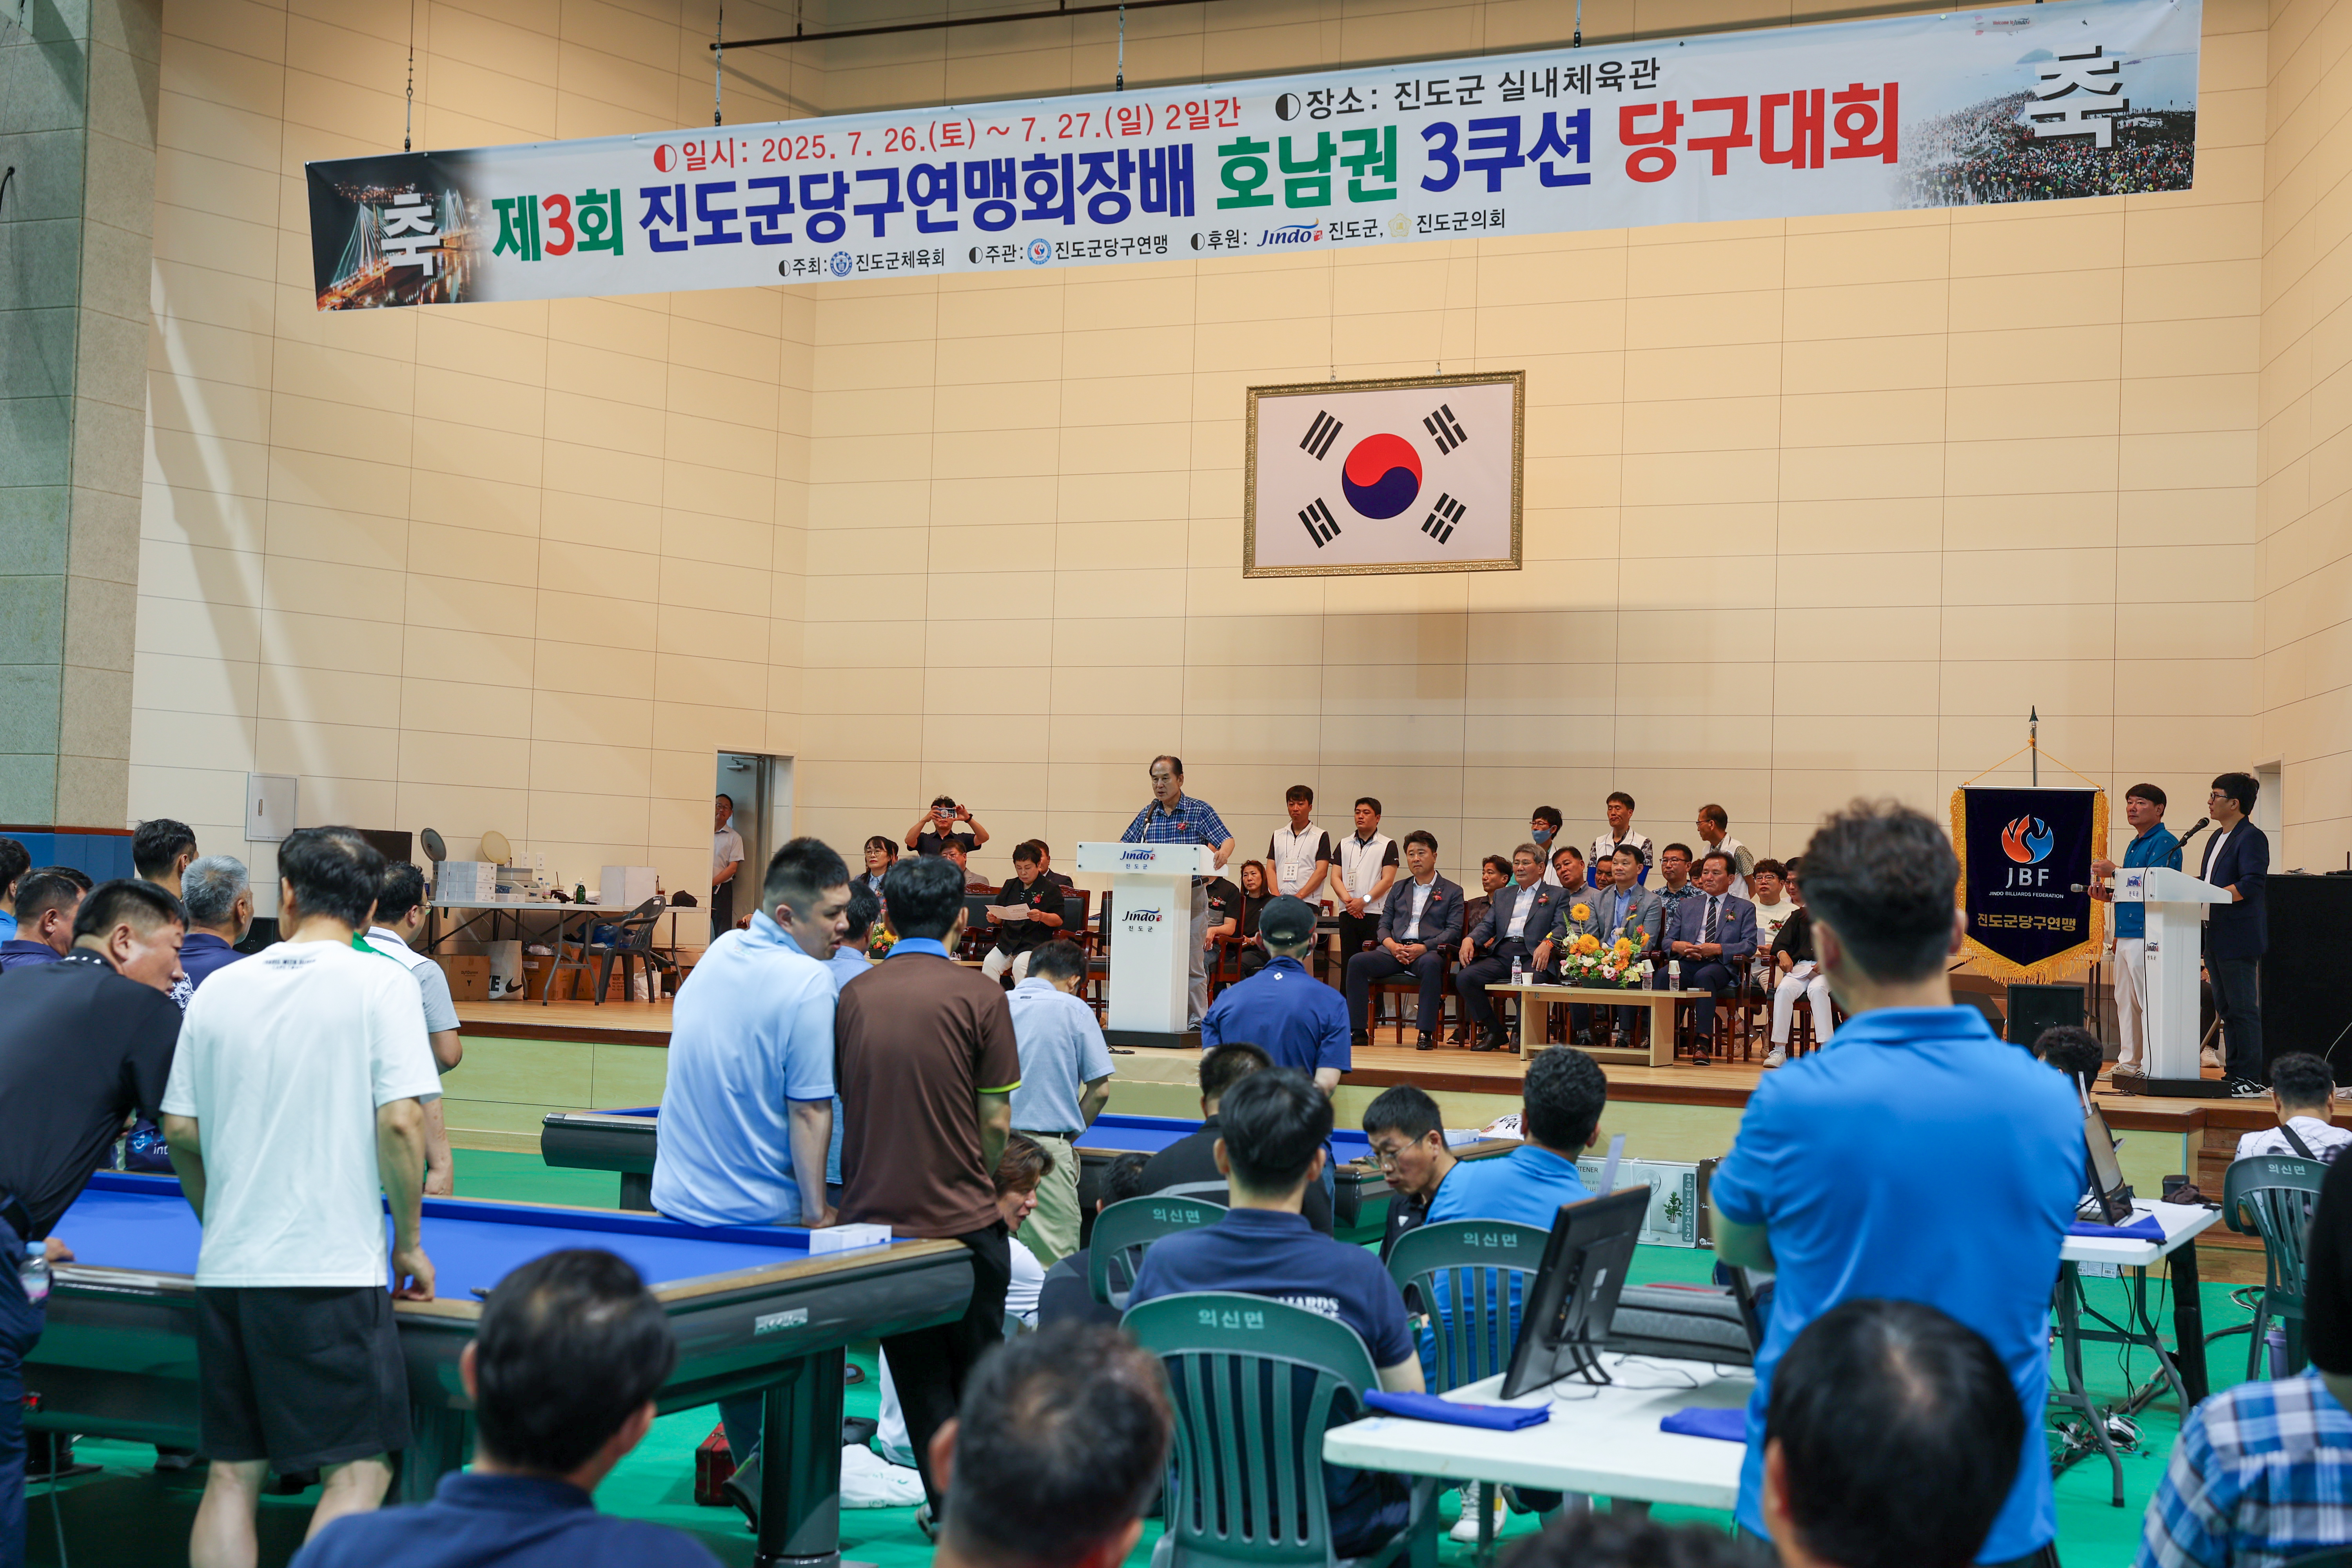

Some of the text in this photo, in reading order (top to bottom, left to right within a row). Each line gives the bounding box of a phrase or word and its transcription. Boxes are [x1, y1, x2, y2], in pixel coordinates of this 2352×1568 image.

[1307, 57, 1661, 119] 장소: 진도군 실내체육관
[2024, 42, 2129, 149] 축
[683, 138, 748, 171] 일시:
[762, 134, 836, 163] 2025.
[849, 131, 872, 158] 7.
[885, 118, 976, 153] 26.(토)
[1021, 117, 1046, 142] 7.
[1058, 103, 1154, 139] 27.(일)
[1165, 96, 1241, 131] 2일간
[492, 82, 1898, 261] 제3회 진도군당구연맹회장배 호남권 3쿠션 당구대회
[381, 192, 441, 276] 축
[1328, 219, 1383, 241] 진도군,
[1417, 208, 1504, 234] 진도군의회
[1207, 229, 1247, 250] 후원:
[1257, 229, 1312, 247] Jindo
[985, 234, 1167, 264] 주관: 진도군당구연맹
[793, 257, 827, 276] 주최:
[856, 248, 944, 272] 진도군체육회
[1120, 850, 1150, 860] Jindo
[2005, 867, 2049, 888] JBF
[1122, 911, 1156, 922] Jindo
[1978, 913, 2076, 932] 진도군당구연맹
[153, 1143, 169, 1155] int
[2268, 1163, 2306, 1176] 의신면
[1152, 1207, 1201, 1223] 의신면
[1463, 1232, 1518, 1248] 의신면
[1278, 1296, 1339, 1312] IARDS
[1198, 1308, 1265, 1330] 의신면
